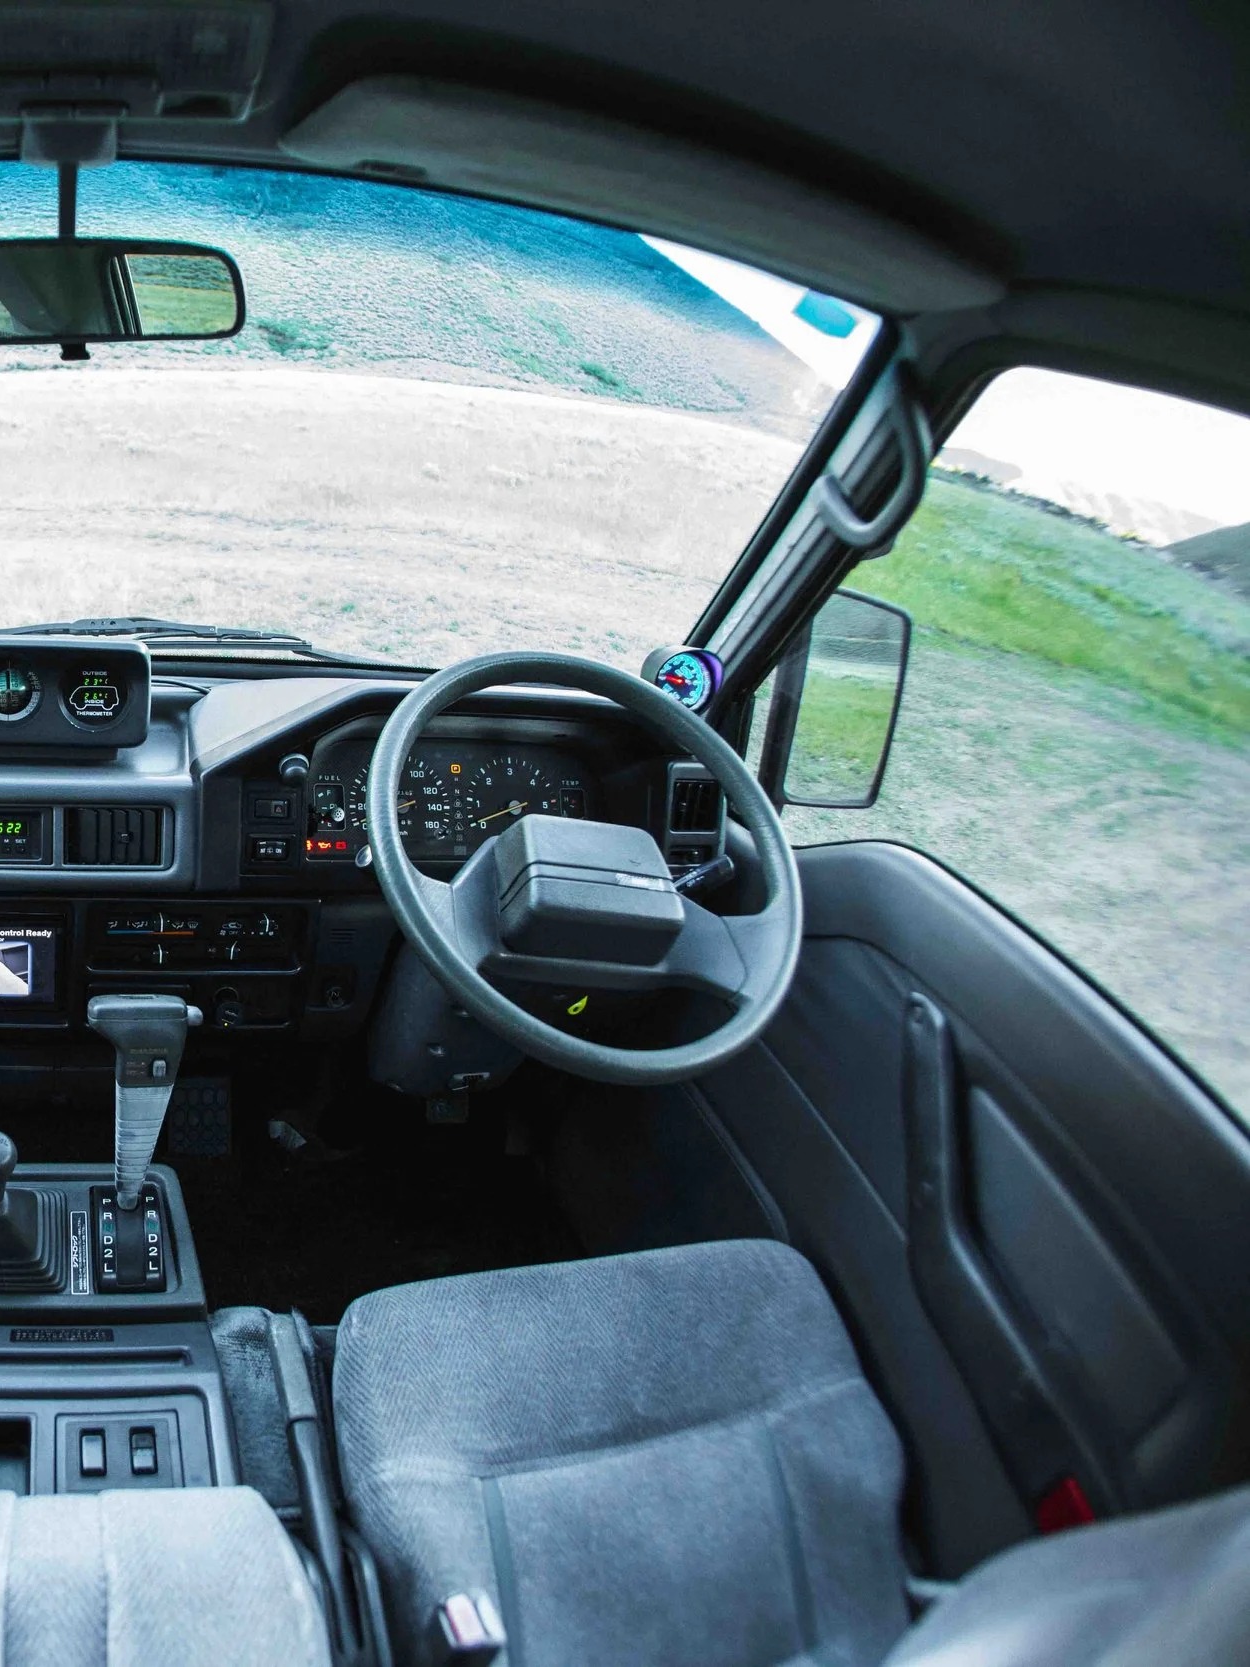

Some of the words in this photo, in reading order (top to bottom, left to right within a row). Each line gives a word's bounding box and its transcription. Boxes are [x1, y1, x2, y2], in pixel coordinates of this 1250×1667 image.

[26, 930, 52, 938] Ready
[104, 1212, 112, 1220] R
[104, 1236, 113, 1245] D
[148, 1234, 158, 1243] D
[104, 1248, 113, 1258] 2
[149, 1246, 158, 1256] 2
[104, 1263, 113, 1272] L
[149, 1260, 158, 1270] L
